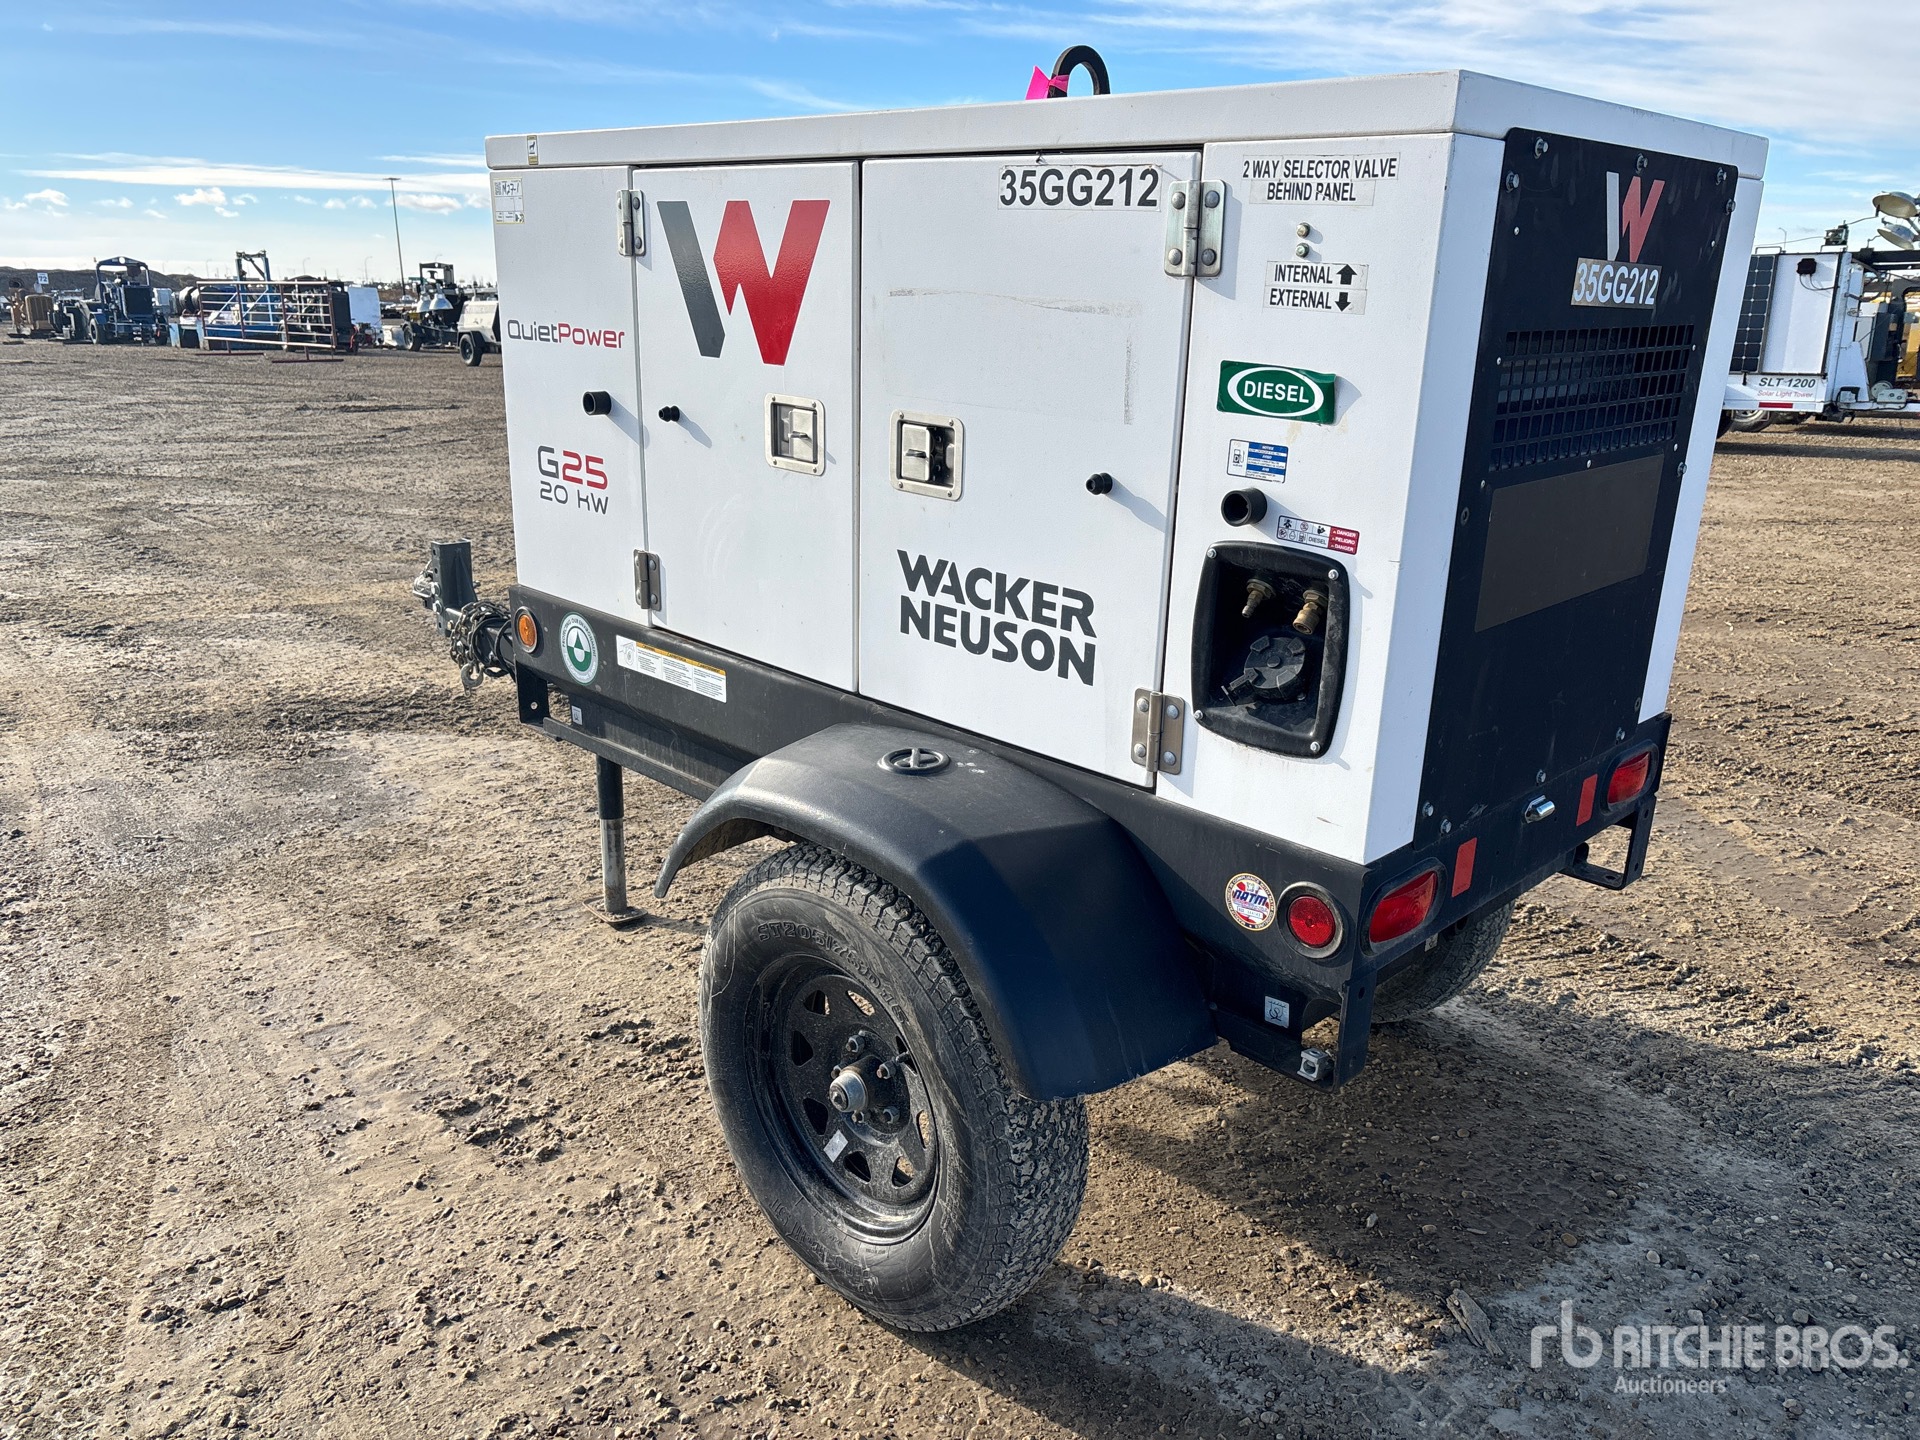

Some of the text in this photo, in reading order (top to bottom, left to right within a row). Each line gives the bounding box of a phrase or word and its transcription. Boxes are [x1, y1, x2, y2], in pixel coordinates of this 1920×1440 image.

[1242, 157, 1397, 179] 2 WAY SELECTOR VALVE
[1000, 168, 1159, 207] 35GG212
[1267, 182, 1356, 202] BEHIND PANEL
[1274, 263, 1333, 284] INTERNAL
[1573, 262, 1660, 306] 35GG212
[1269, 287, 1332, 309] EXTERNAL
[507, 319, 626, 349] QuietPower
[1243, 380, 1310, 404] DIESEL
[1758, 377, 1816, 388] SLT 1200
[1757, 389, 1775, 397] Solar
[1775, 390, 1793, 399] Light
[537, 445, 608, 490] G25
[540, 480, 568, 504] 20
[1308, 536, 1327, 546] DIESEL
[1335, 536, 1356, 545] PELIGRO
[1336, 528, 1357, 538] DANGER
[1334, 543, 1354, 552] DANGER
[896, 549, 1098, 639] WACKER
[900, 594, 1096, 687] NEUSON
